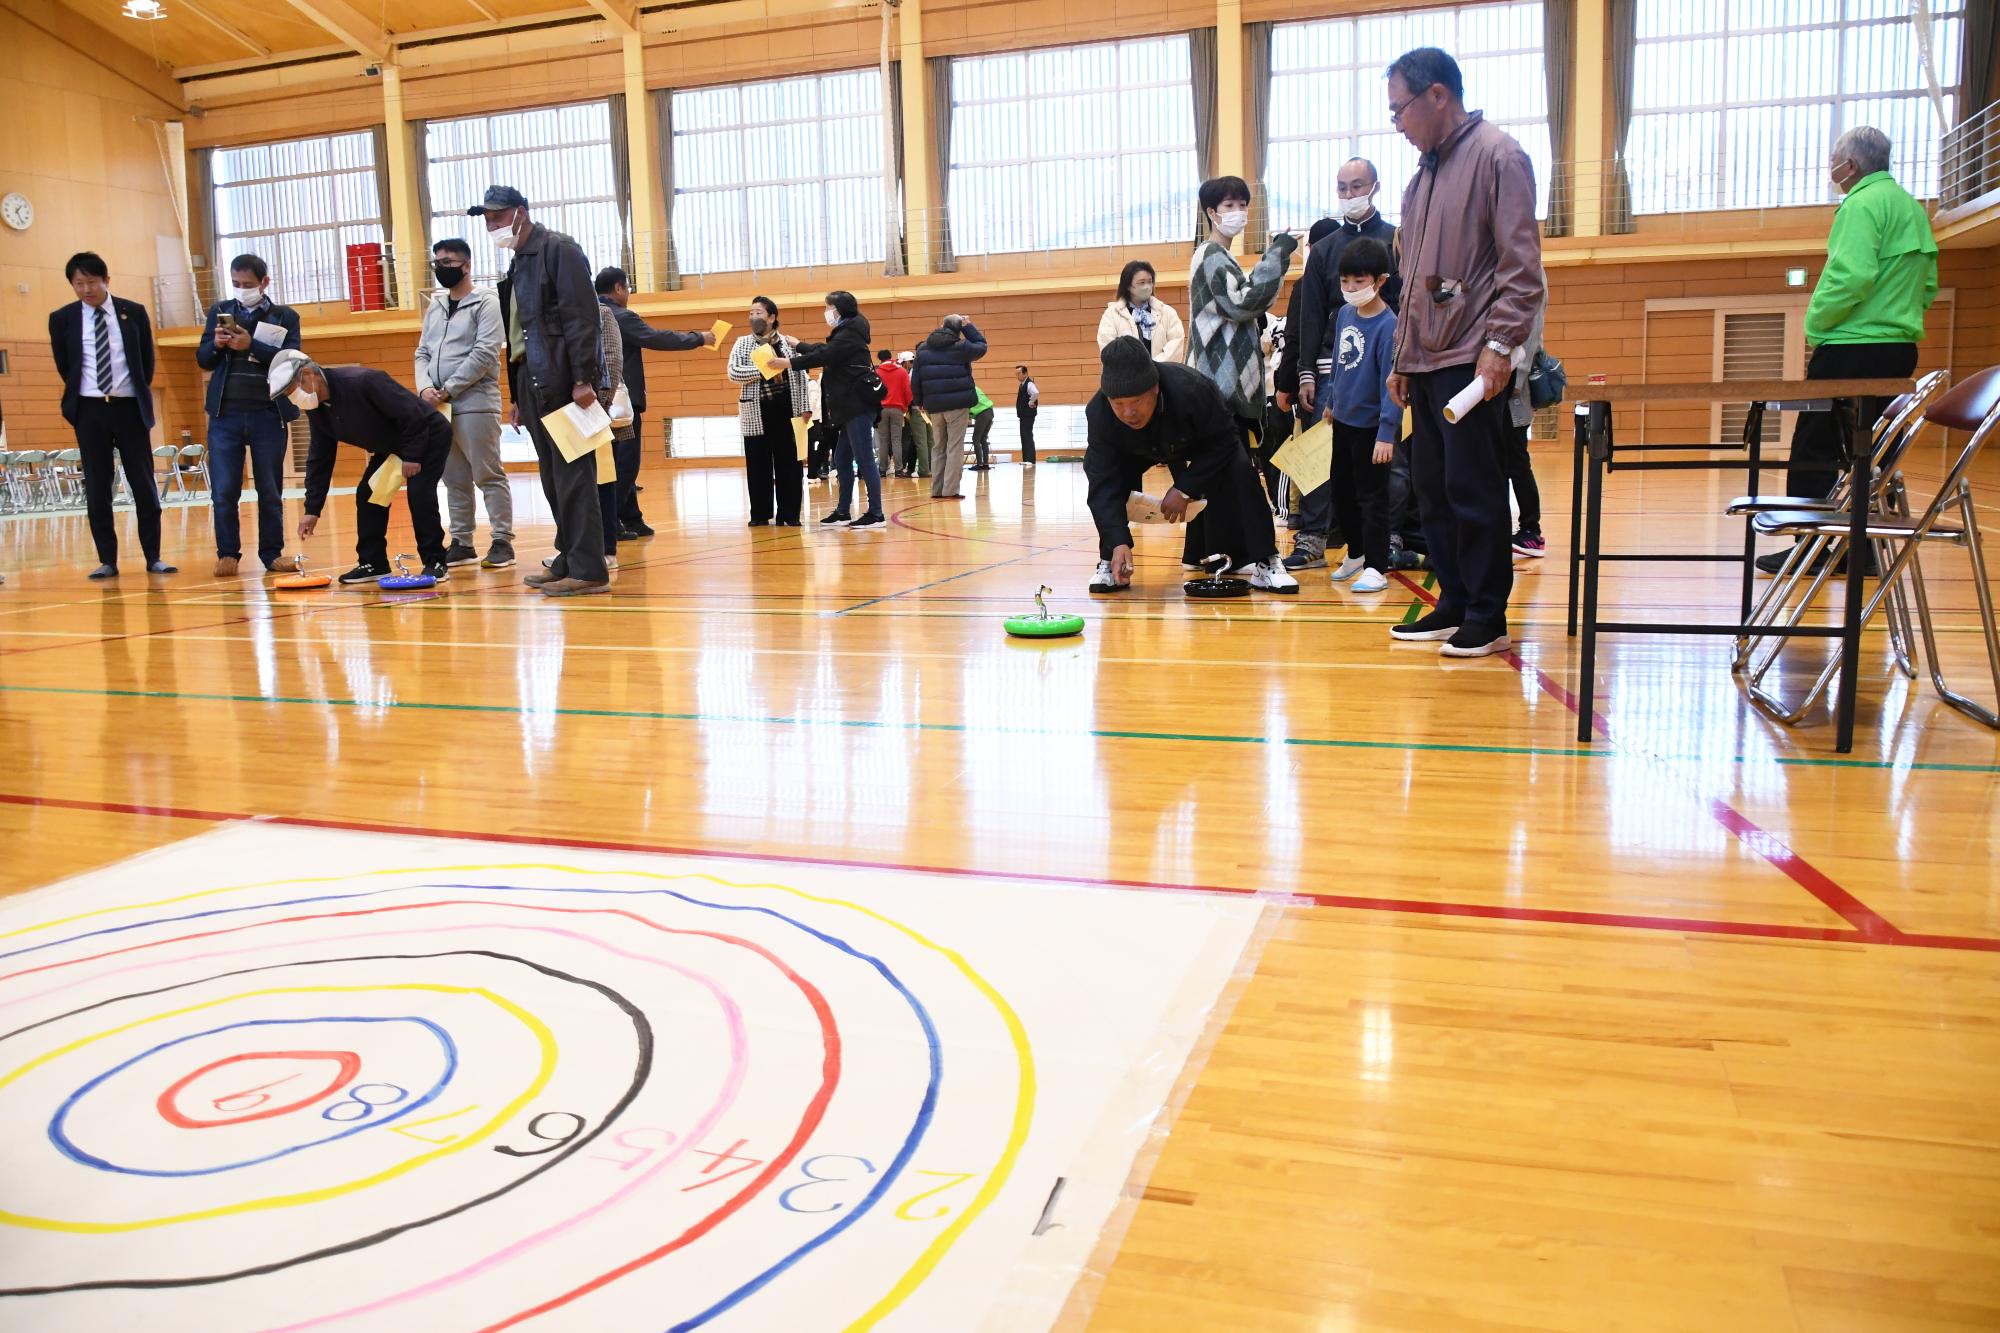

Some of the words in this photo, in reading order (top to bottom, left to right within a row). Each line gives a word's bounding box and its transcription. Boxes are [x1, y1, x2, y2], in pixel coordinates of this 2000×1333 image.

[322, 1083, 408, 1121] 8
[386, 1104, 480, 1144] 7
[588, 1127, 678, 1171] 5
[680, 1138, 763, 1192] 4
[778, 1154, 877, 1213] 3
[894, 1169, 978, 1221] 2
[1031, 1176, 1068, 1237] 1
